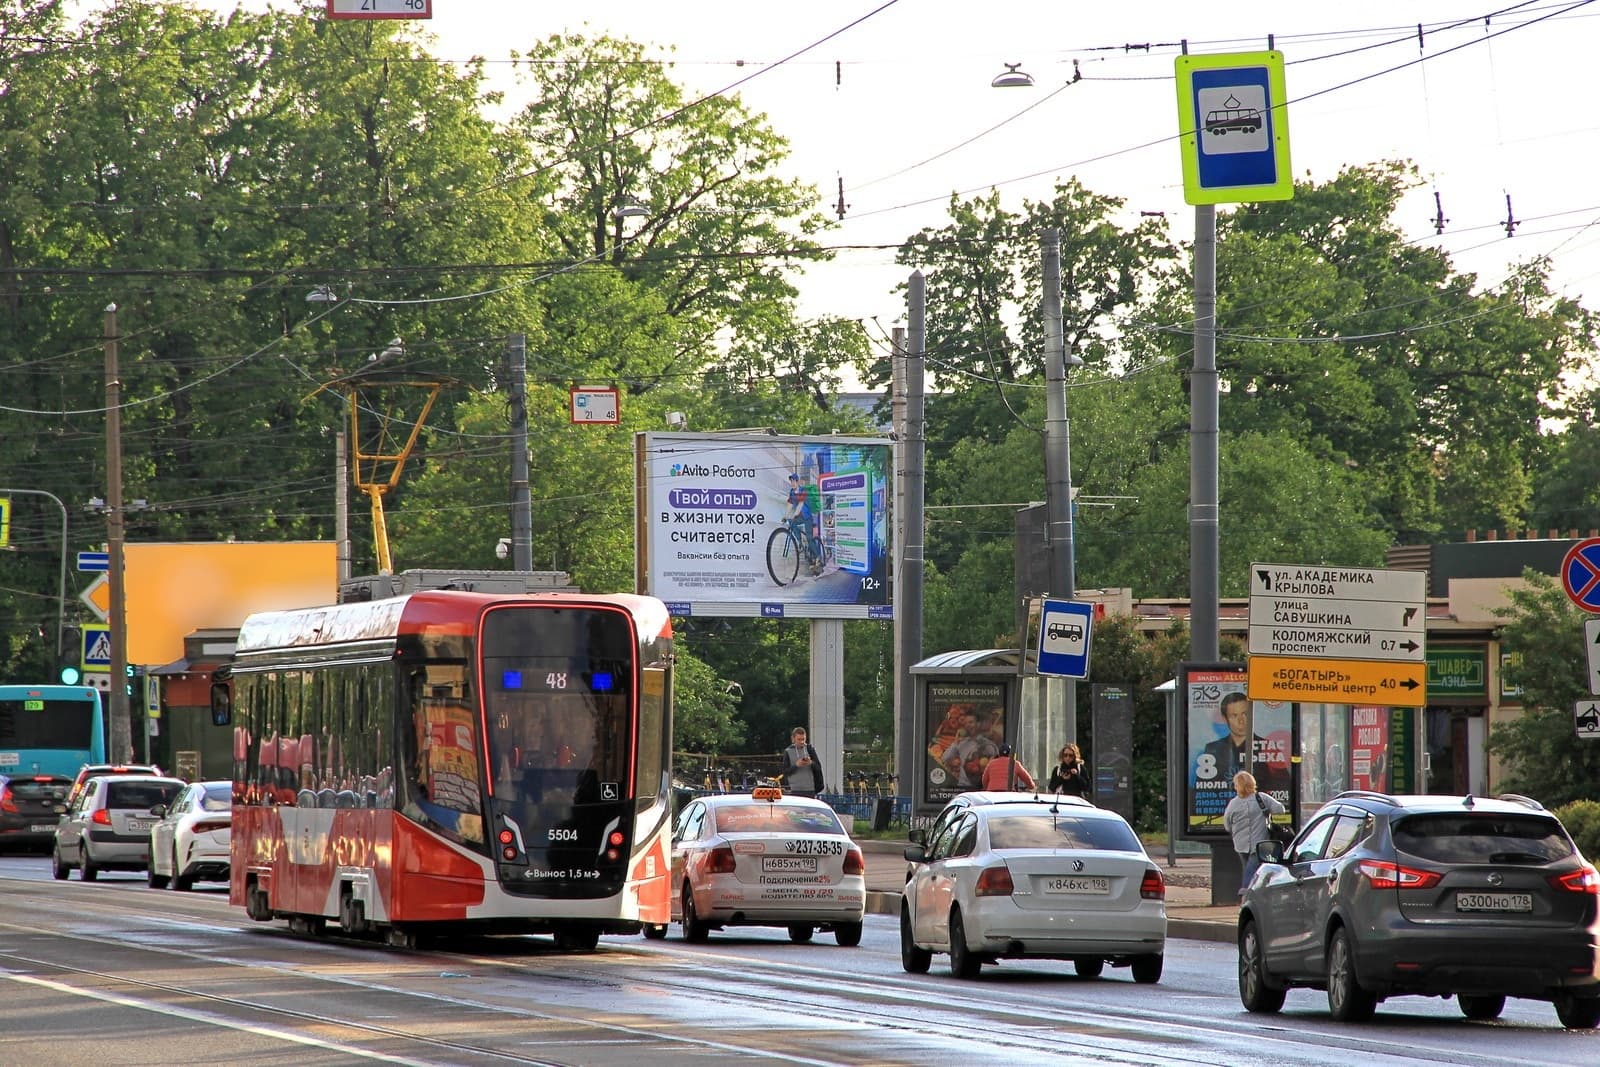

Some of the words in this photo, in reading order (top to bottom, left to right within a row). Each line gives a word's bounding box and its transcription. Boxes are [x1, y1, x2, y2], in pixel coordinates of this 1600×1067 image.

[585, 411, 592, 419] 21
[607, 411, 615, 419] 48
[682, 465, 709, 477] Avito
[713, 465, 755, 478] Работа
[673, 488, 709, 505] Твой
[714, 494, 752, 506] опыт
[661, 512, 669, 523] в
[673, 512, 723, 524] жизни
[727, 513, 765, 525] тоже
[671, 529, 755, 543] считается!
[677, 552, 712, 560] Вакансии
[713, 552, 726, 560] без
[1275, 571, 1292, 583] ул.
[1295, 570, 1374, 584] АКАДЕМИКА
[861, 578, 880, 590] 12+
[1275, 582, 1335, 595] КРЫЛОВА
[1274, 600, 1309, 611] улица
[1274, 611, 1352, 625] САВУШКИНА
[1272, 630, 1371, 644] КОЛОМЯЖСКИЙ
[1381, 640, 1396, 651] 0.7
[1272, 643, 1327, 653] проспект
[1437, 658, 1472, 675] ШАВЕР
[546, 673, 567, 689] 48
[1272, 669, 1351, 682] «БОГАТЫРЬ»
[1380, 678, 1396, 689] 4.0
[932, 687, 1000, 696] ТОРЖКОВСКИЙ
[1272, 681, 1338, 692] мебельный
[1343, 684, 1377, 695] центр
[1196, 753, 1218, 779] 8
[1196, 781, 1228, 789] ИЮЛЯ
[1271, 790, 1289, 801] 2024
[548, 829, 578, 840] 5504
[796, 840, 842, 855] 237-35-35
[534, 870, 565, 878] Вынос
[569, 869, 582, 879] 1,5
[1092, 879, 1106, 888] 198
[1511, 895, 1529, 905] 178
